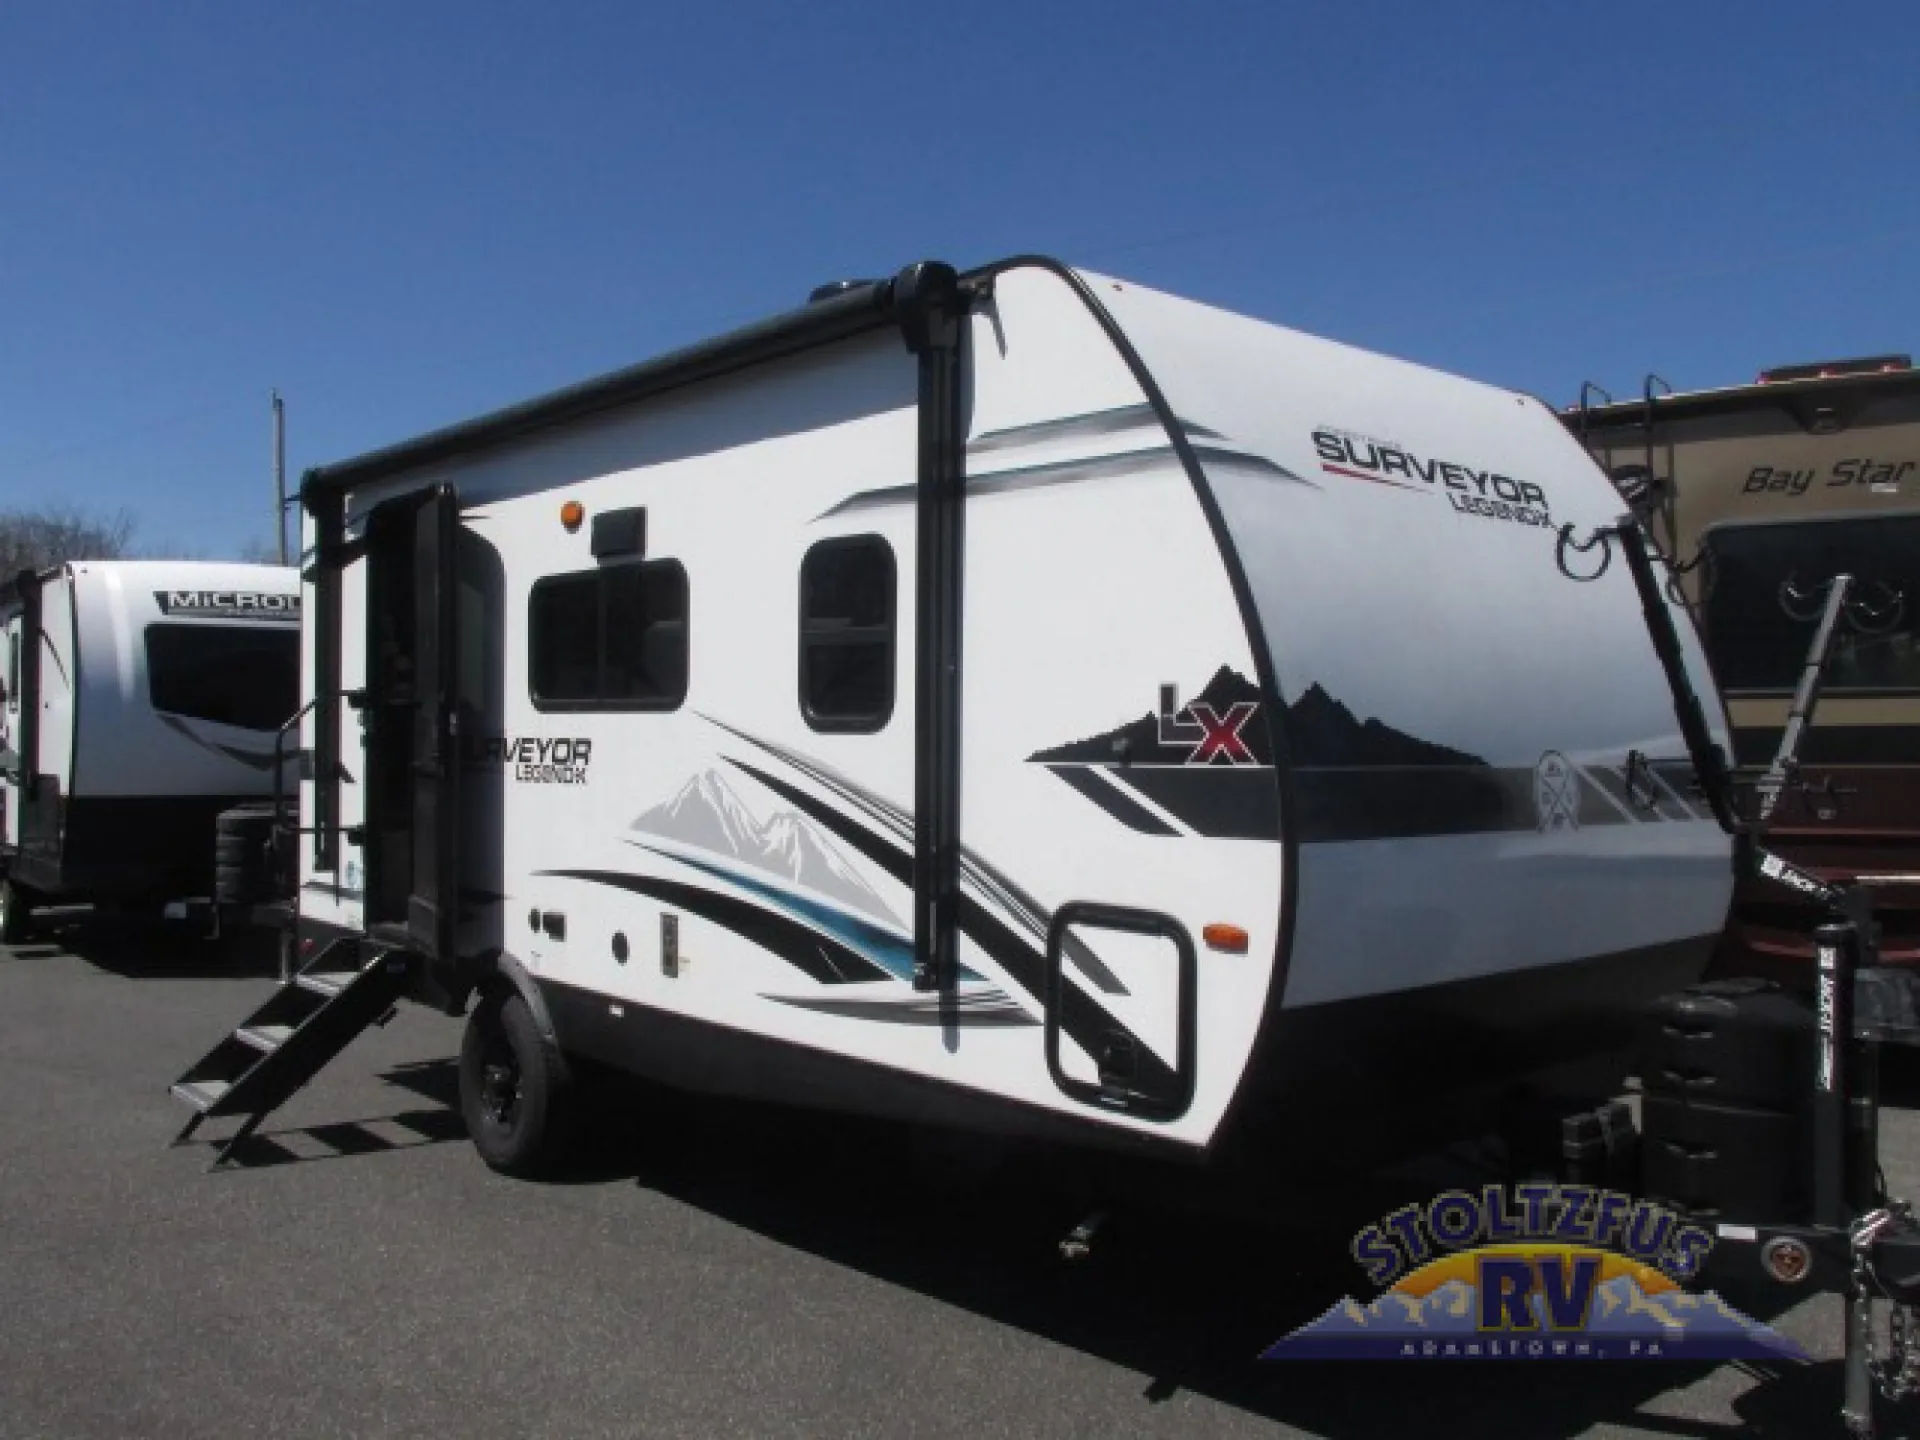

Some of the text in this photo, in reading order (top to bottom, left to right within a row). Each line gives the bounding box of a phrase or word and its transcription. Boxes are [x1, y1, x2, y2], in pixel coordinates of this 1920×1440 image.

[1312, 431, 1548, 511] SURVEYOR
[1743, 458, 1916, 496] Bay Star
[1158, 681, 1260, 766] LX
